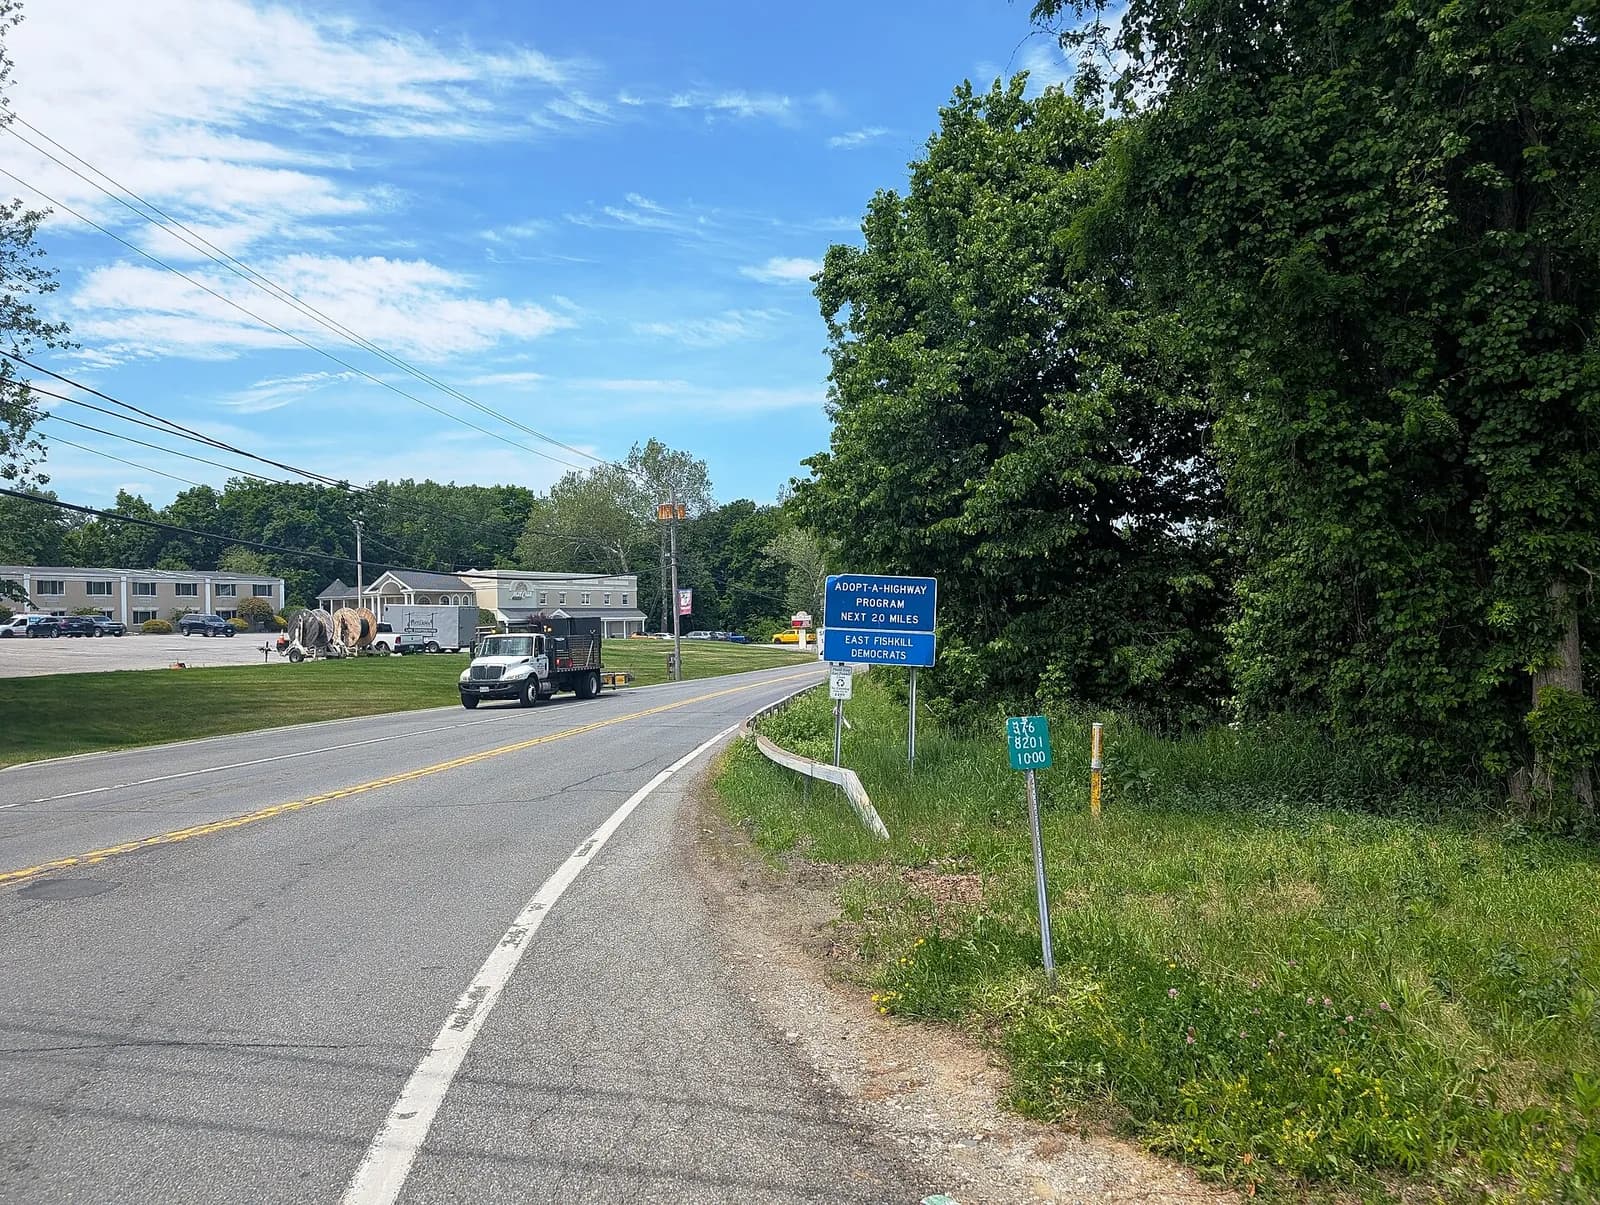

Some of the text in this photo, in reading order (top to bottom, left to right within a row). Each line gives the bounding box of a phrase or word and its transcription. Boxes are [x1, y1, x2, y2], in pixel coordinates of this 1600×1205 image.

[835, 582, 928, 595] ADOPT-A-HIGHWAY
[856, 598, 905, 609] PROGRAM
[841, 612, 867, 623] NEXT
[889, 614, 919, 624] MILES
[845, 635, 914, 647] EAST FISHKILL
[851, 648, 907, 660] DEMOCRATS
[1012, 721, 1035, 734] 376
[1014, 736, 1043, 749] 8201
[1017, 751, 1046, 765] 1000
